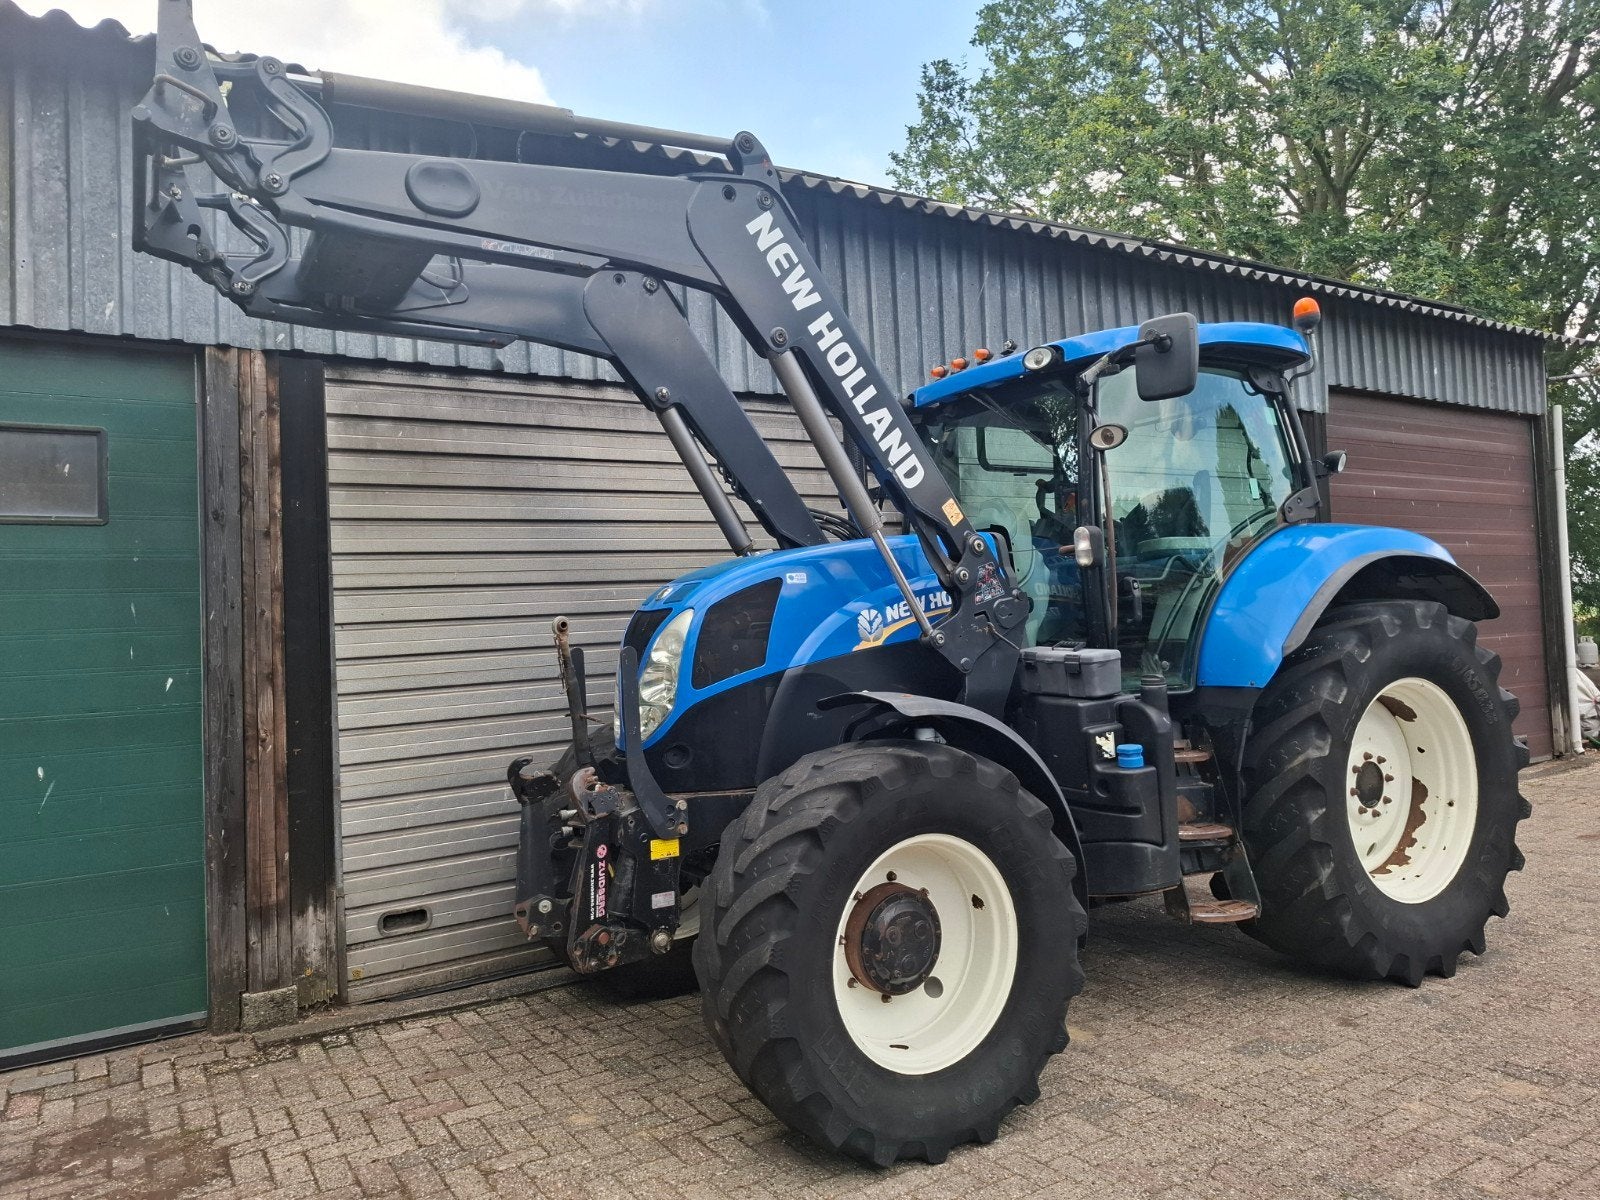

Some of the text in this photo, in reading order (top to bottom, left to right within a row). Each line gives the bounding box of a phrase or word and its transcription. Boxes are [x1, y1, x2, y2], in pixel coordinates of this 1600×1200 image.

[745, 210, 925, 489] NEW HOLLAND
[598, 860, 606, 918] ZUIDBERG
